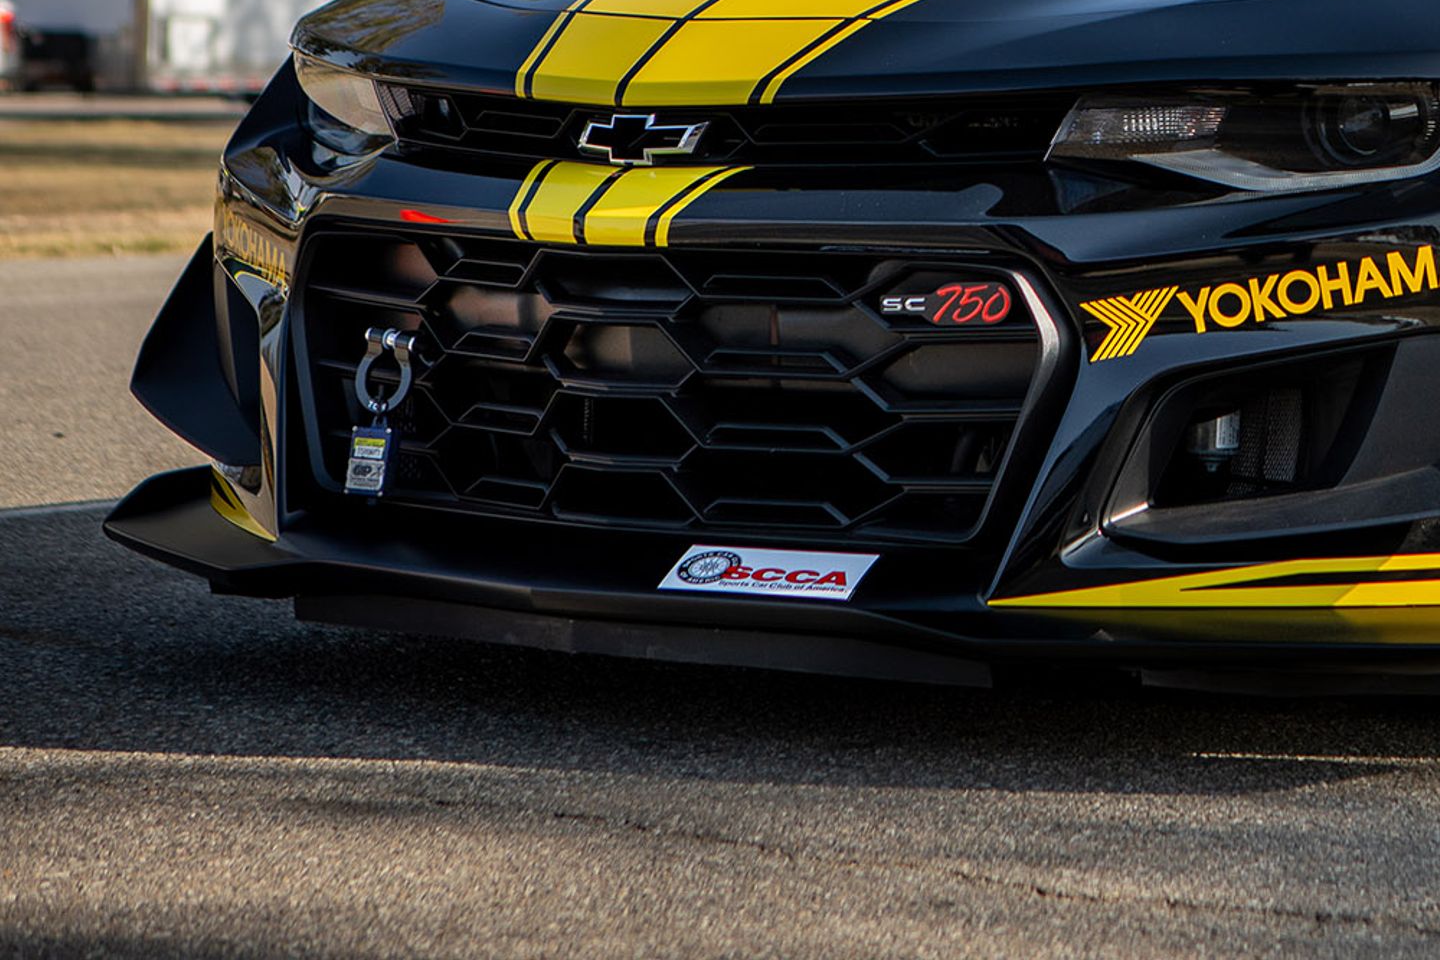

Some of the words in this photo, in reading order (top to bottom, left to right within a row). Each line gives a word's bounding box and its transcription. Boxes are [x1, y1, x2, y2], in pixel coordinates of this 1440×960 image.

[882, 297, 926, 311] SC
[933, 284, 1011, 323] 750
[721, 565, 847, 586] SCCA
